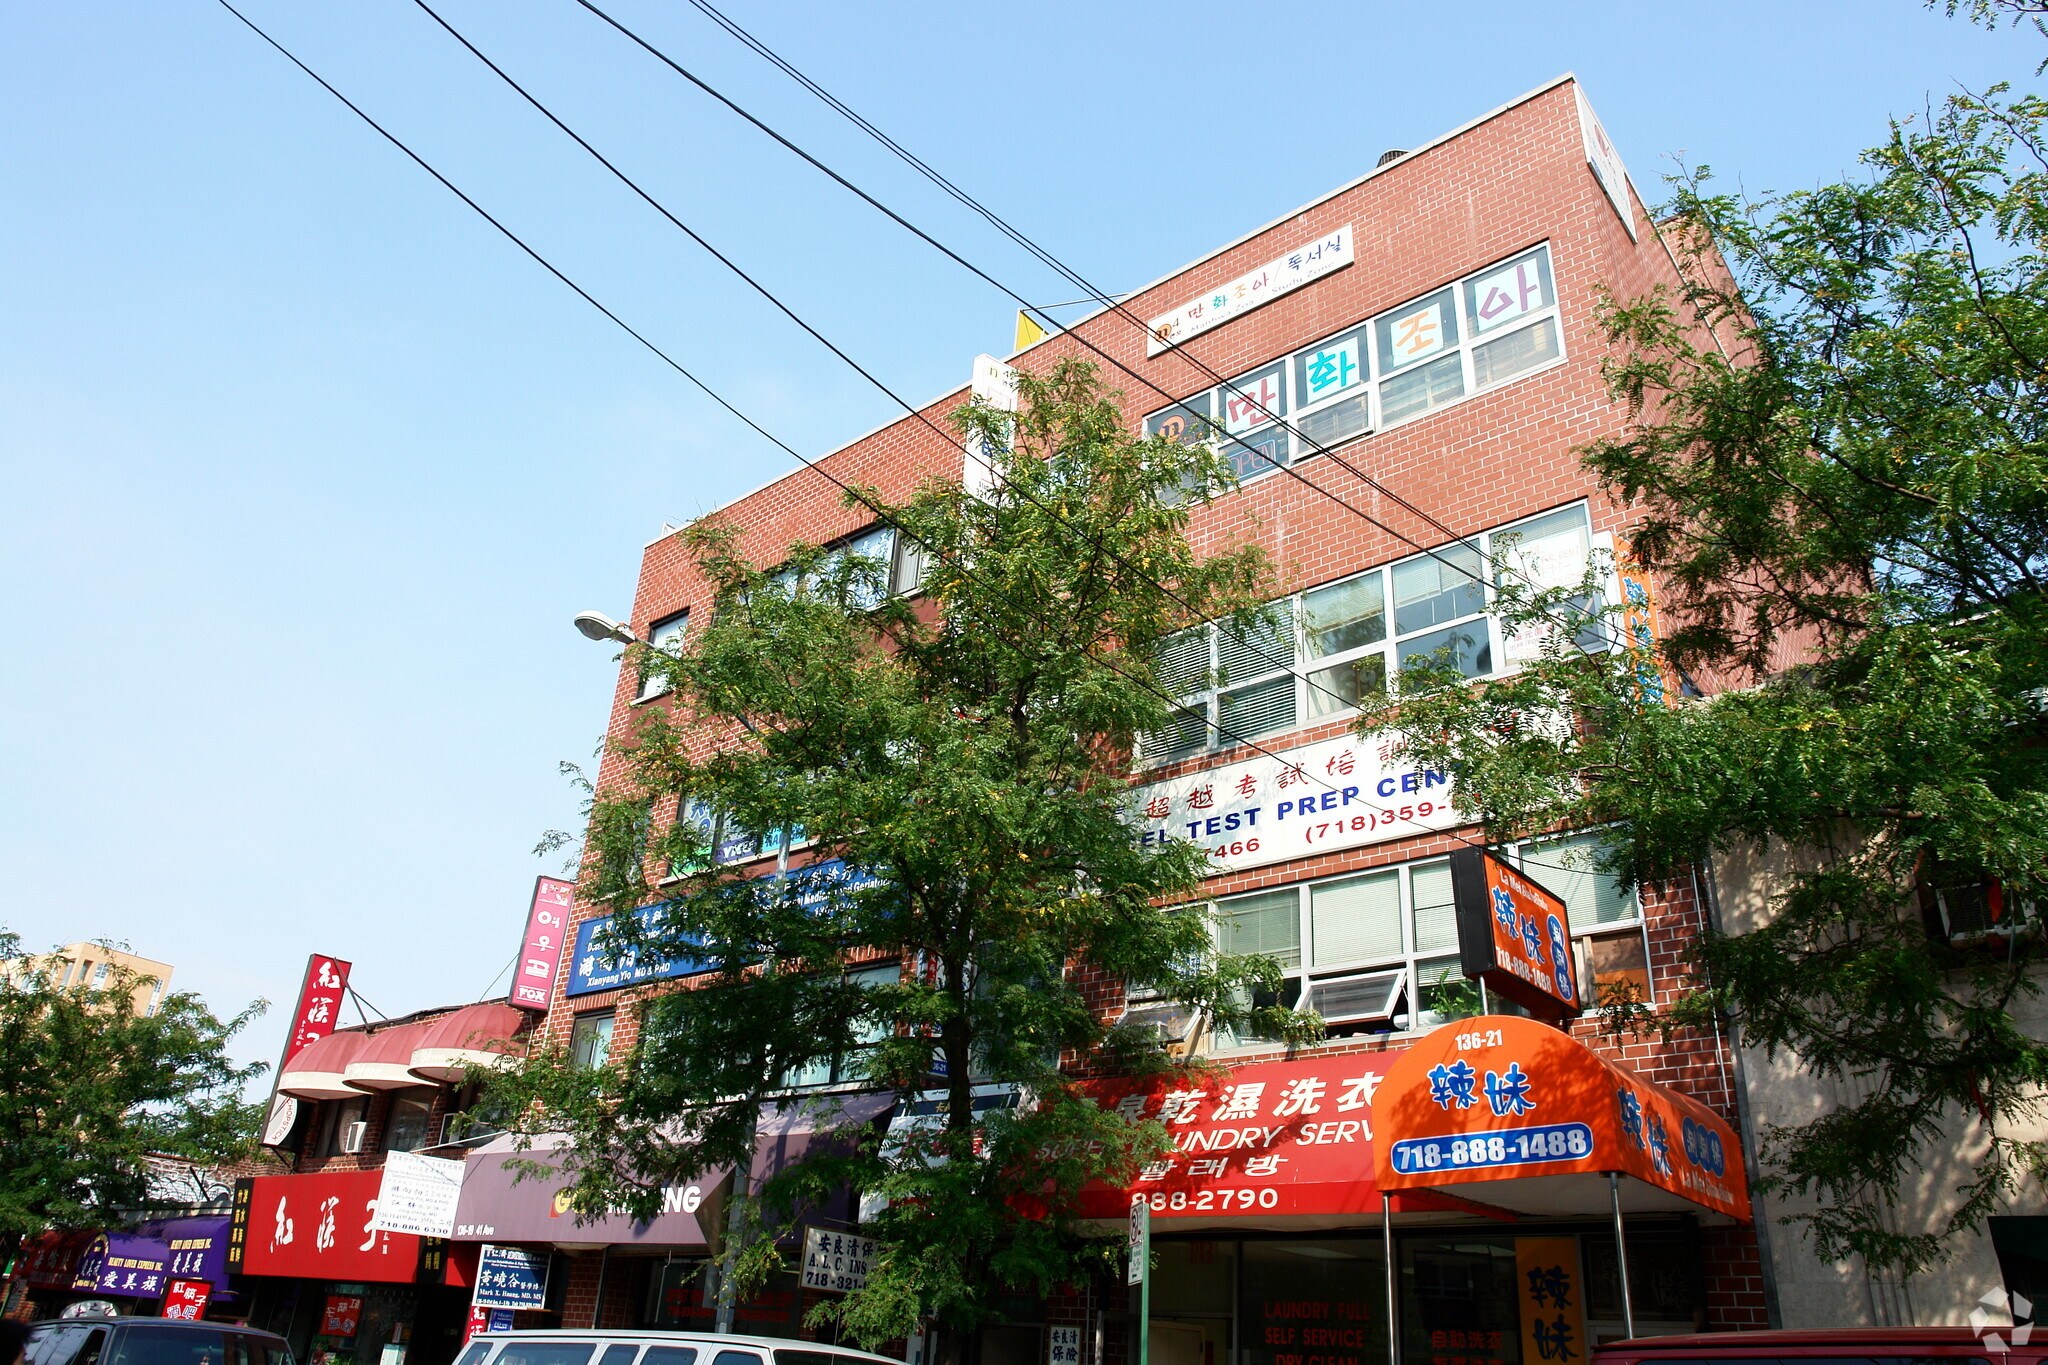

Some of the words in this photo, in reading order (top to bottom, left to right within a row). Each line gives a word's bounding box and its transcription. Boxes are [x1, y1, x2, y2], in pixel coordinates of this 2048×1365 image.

[1288, 235, 1341, 270] 독서실
[1271, 276, 1303, 294] Study
[1307, 261, 1335, 279] Zone
[1188, 807, 1261, 839] TEST
[1277, 786, 1360, 820] PREP
[1376, 764, 1448, 798] CEN
[1499, 868, 1509, 886] La
[1509, 874, 1521, 893] Mei
[1491, 885, 1545, 966] 辣妹
[525, 910, 560, 979] 여우골
[587, 974, 620, 988] Xianyang
[634, 967, 646, 978] MD
[654, 962, 670, 974] PHD
[1495, 945, 1552, 994] 718-888-1488
[518, 987, 545, 1001] FOX
[1455, 1030, 1503, 1050] 136-21
[1426, 1059, 1536, 1117] 辣妹
[1171, 1125, 1286, 1153] UNDRY
[1617, 1085, 1672, 1180] 辣妹
[1397, 1129, 1587, 1170] 718-888-1488
[818, 1233, 876, 1258] 安良清保
[107, 1257, 123, 1267] BEAUTY
[124, 1258, 137, 1269] LOVER
[137, 1260, 154, 1270] EXPRESS
[103, 1270, 158, 1292] 愛美族
[172, 1281, 206, 1307] 紅筷子
[480, 1288, 494, 1296] Mark
[1263, 1301, 1330, 1320] LAUNDRY
[1336, 1302, 1372, 1321] FULL
[1527, 1265, 1579, 1363] 辣妹
[1264, 1327, 1295, 1345] SELF
[1303, 1328, 1365, 1348] SERVICE
[1431, 1330, 1505, 1349] 自助洗衣
